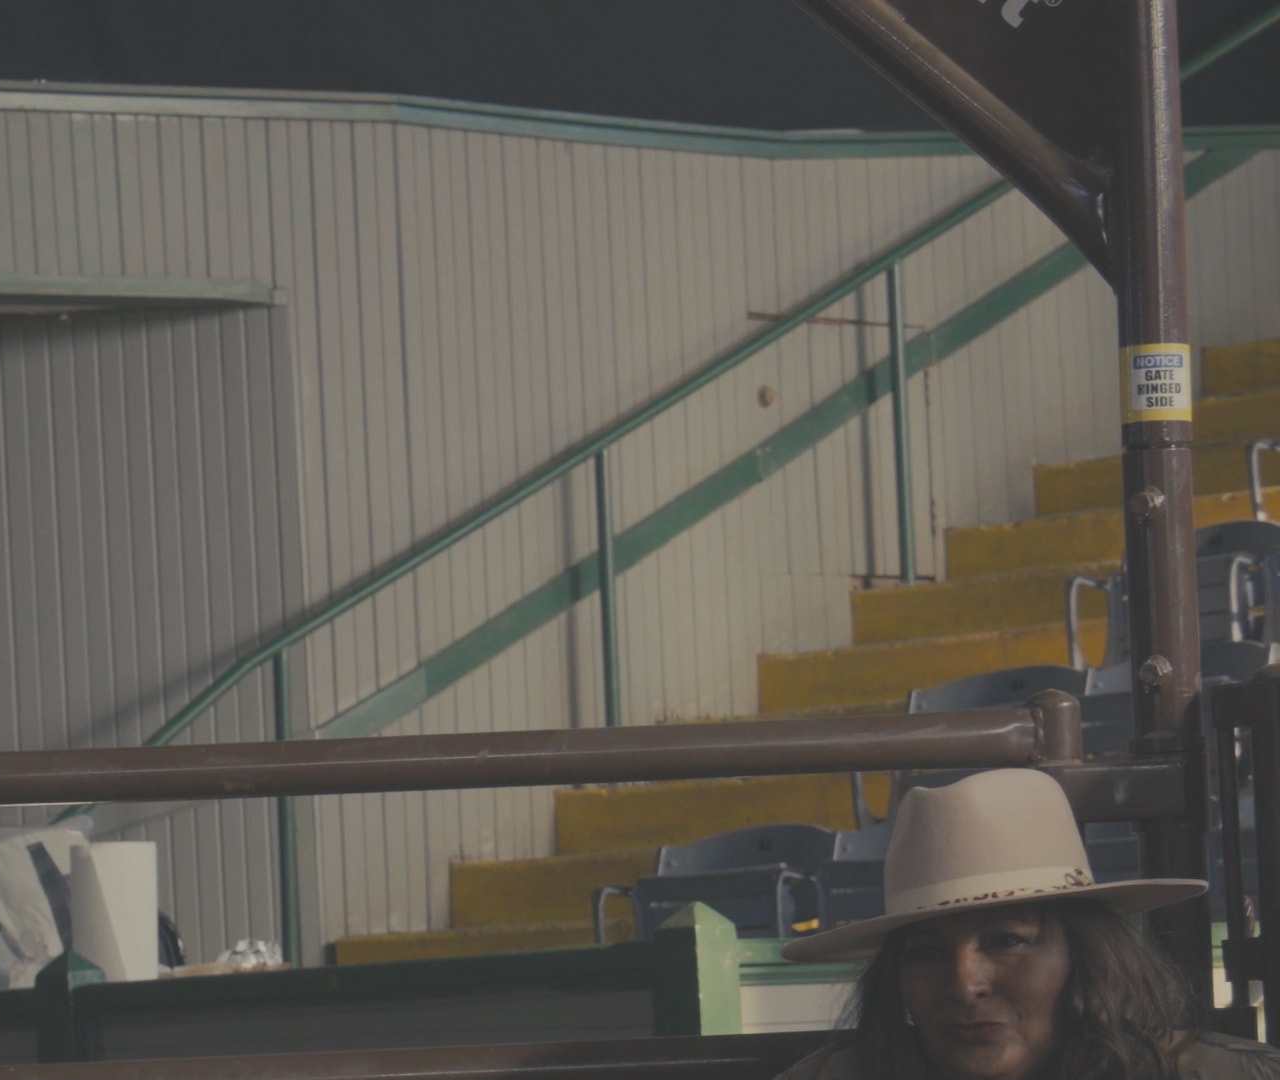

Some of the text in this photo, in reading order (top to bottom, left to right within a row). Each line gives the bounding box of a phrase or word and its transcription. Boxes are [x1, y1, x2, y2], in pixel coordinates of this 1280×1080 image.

[1136, 356, 1180, 367] NOTICE
[1145, 370, 1175, 381] GATE
[1137, 383, 1181, 395] HINGED
[1146, 396, 1175, 407] SIDE
